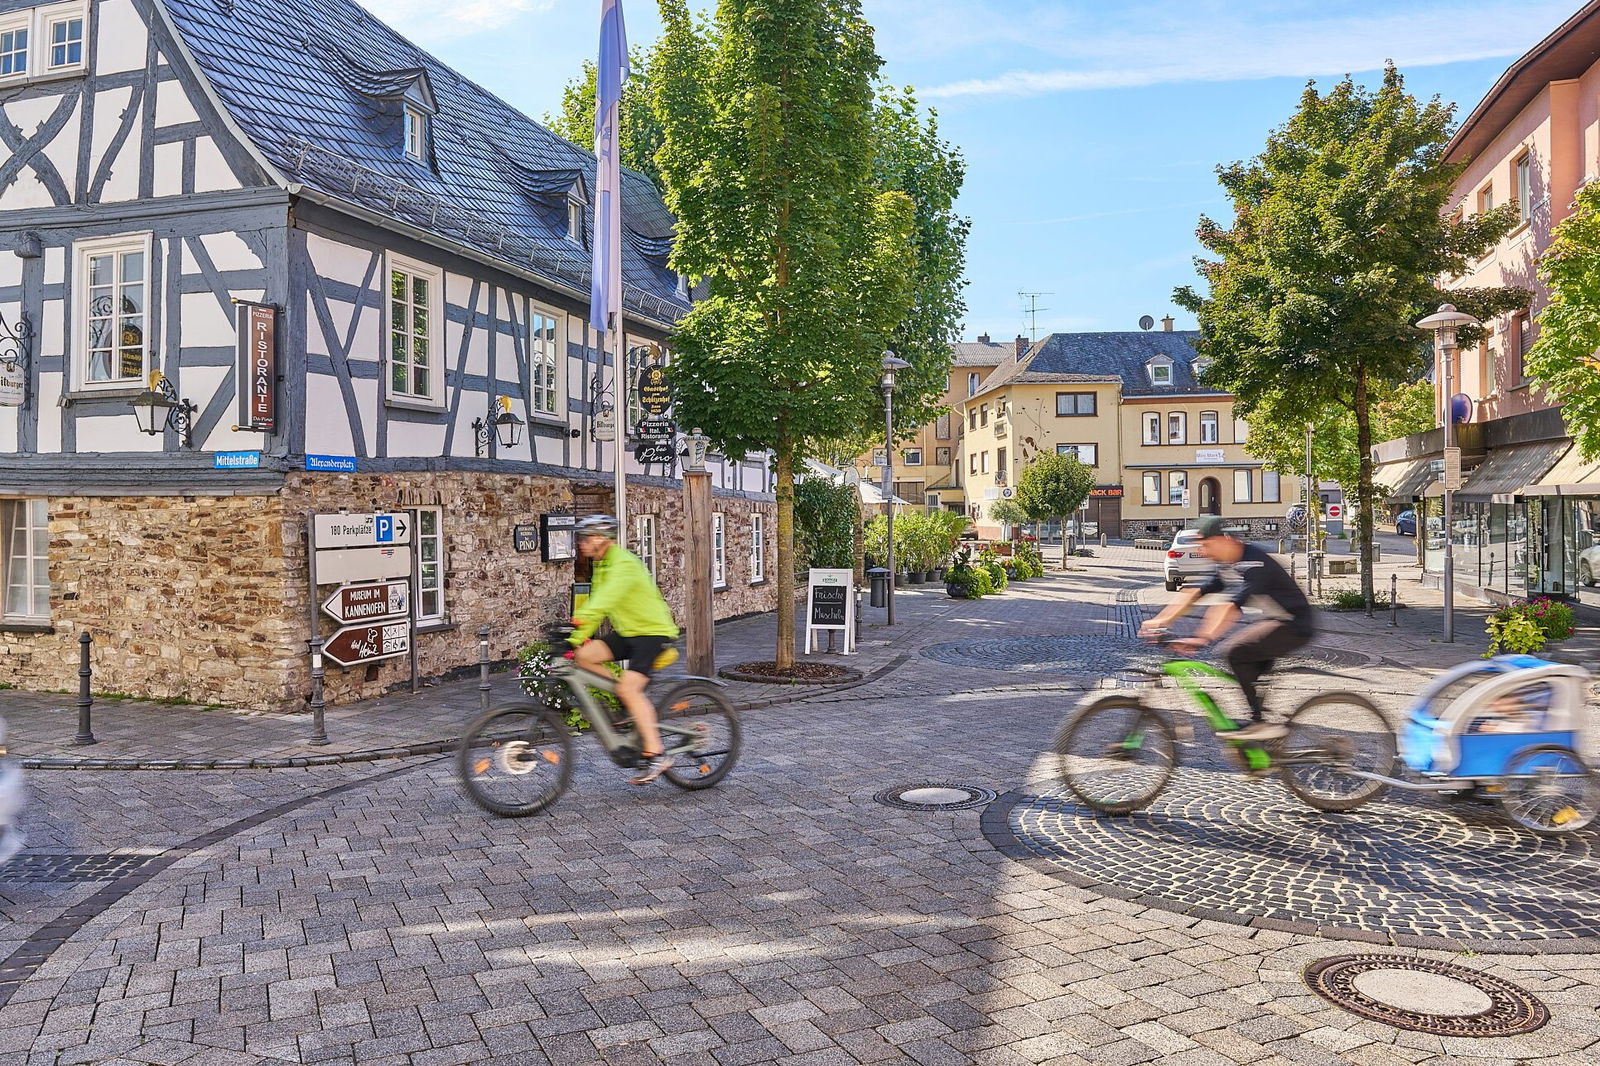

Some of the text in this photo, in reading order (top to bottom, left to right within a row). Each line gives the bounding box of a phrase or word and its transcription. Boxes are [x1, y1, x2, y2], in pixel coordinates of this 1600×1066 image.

[252, 311, 273, 319] PIZZERIA
[256, 321, 268, 413] RISTORANTE
[0, 376, 24, 389] itburger
[216, 453, 258, 466] Mittelstraße
[639, 447, 672, 462] Pino
[310, 457, 355, 471] Alexanderplatz
[331, 524, 372, 537] 180 Parkplätze
[379, 519, 389, 539] P
[519, 540, 535, 551] PINO
[350, 588, 380, 602] MUSEUM IM
[815, 587, 844, 600] Frische
[344, 602, 386, 618] KANNENOFEN
